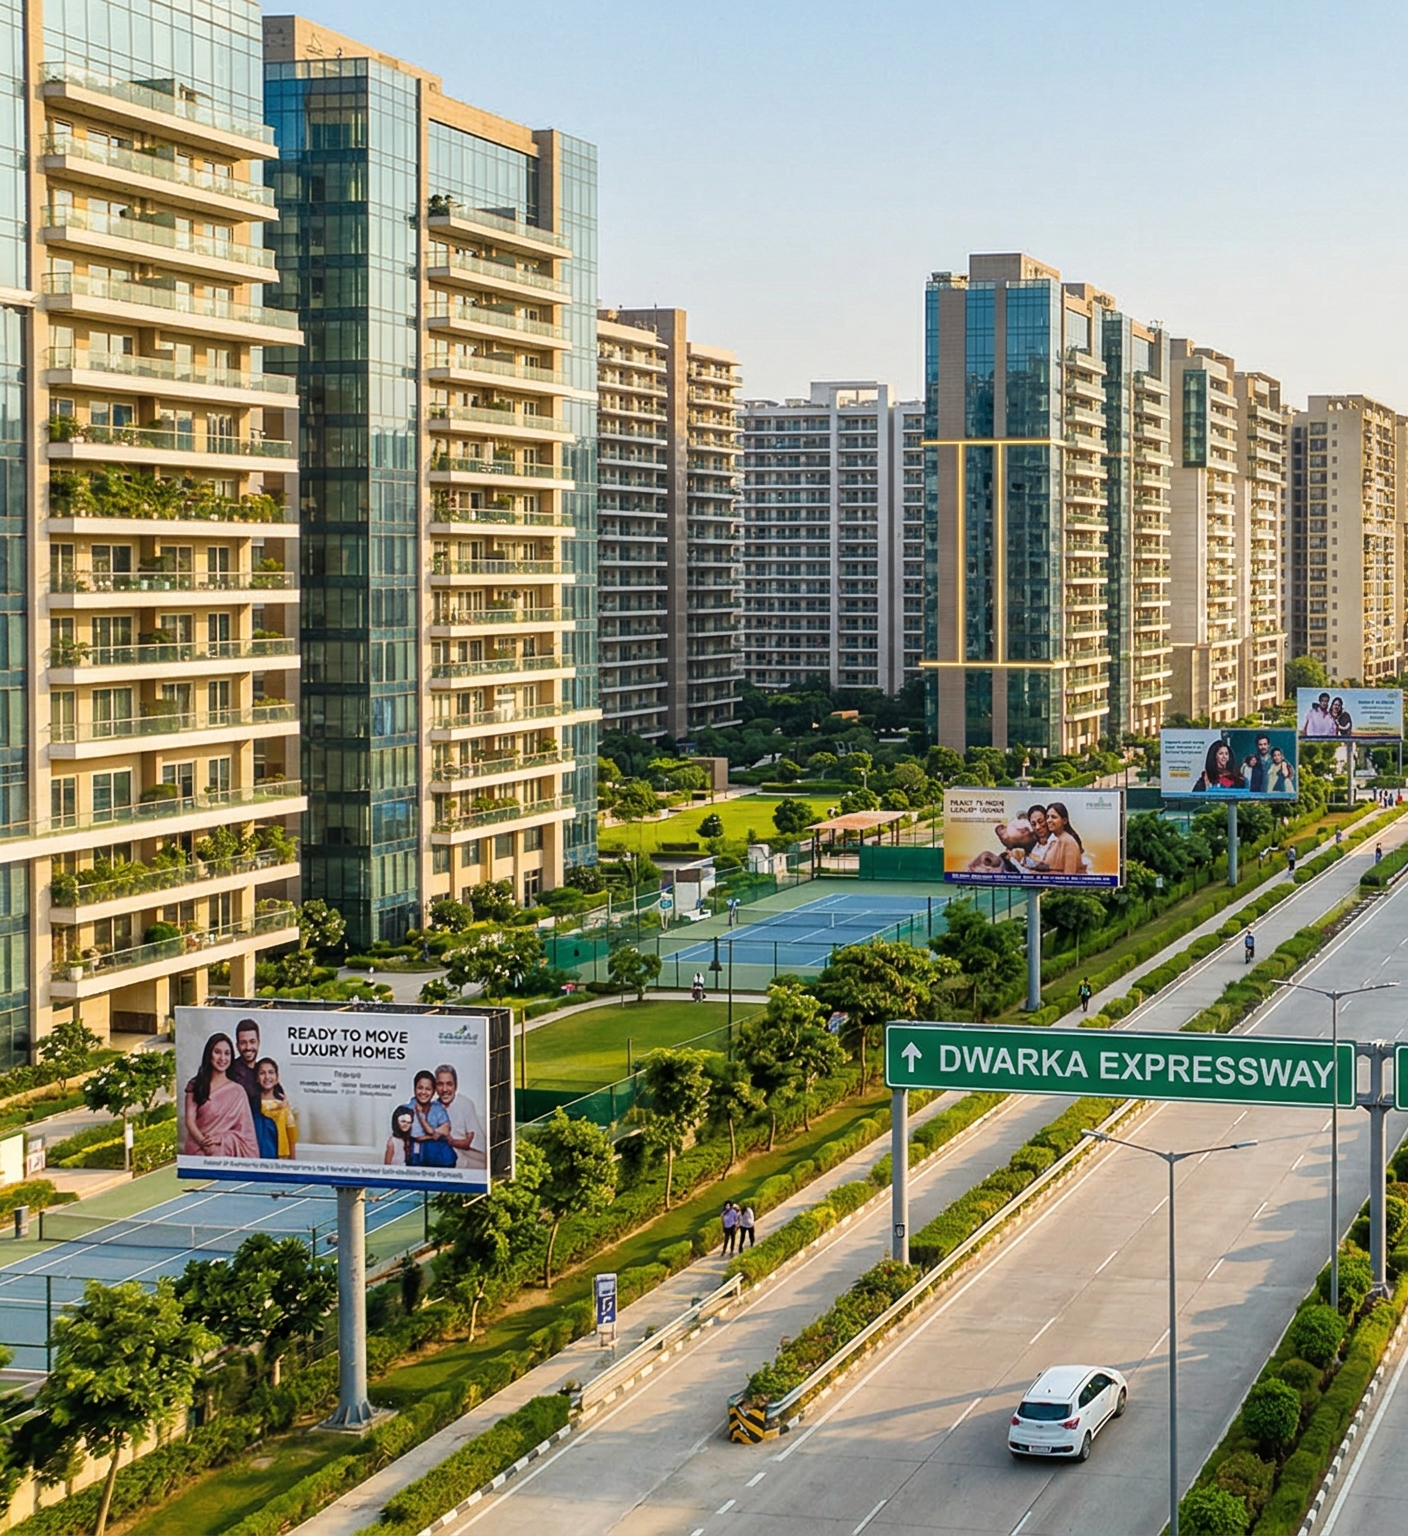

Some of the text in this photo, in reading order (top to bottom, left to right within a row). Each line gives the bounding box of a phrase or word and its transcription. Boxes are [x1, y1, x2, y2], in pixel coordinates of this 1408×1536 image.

[288, 1026, 408, 1044] READY TO MOVE
[290, 1043, 406, 1060] LUXURY HOMES
[939, 1044, 1336, 1089] DWARKA EXPRESSWAY
